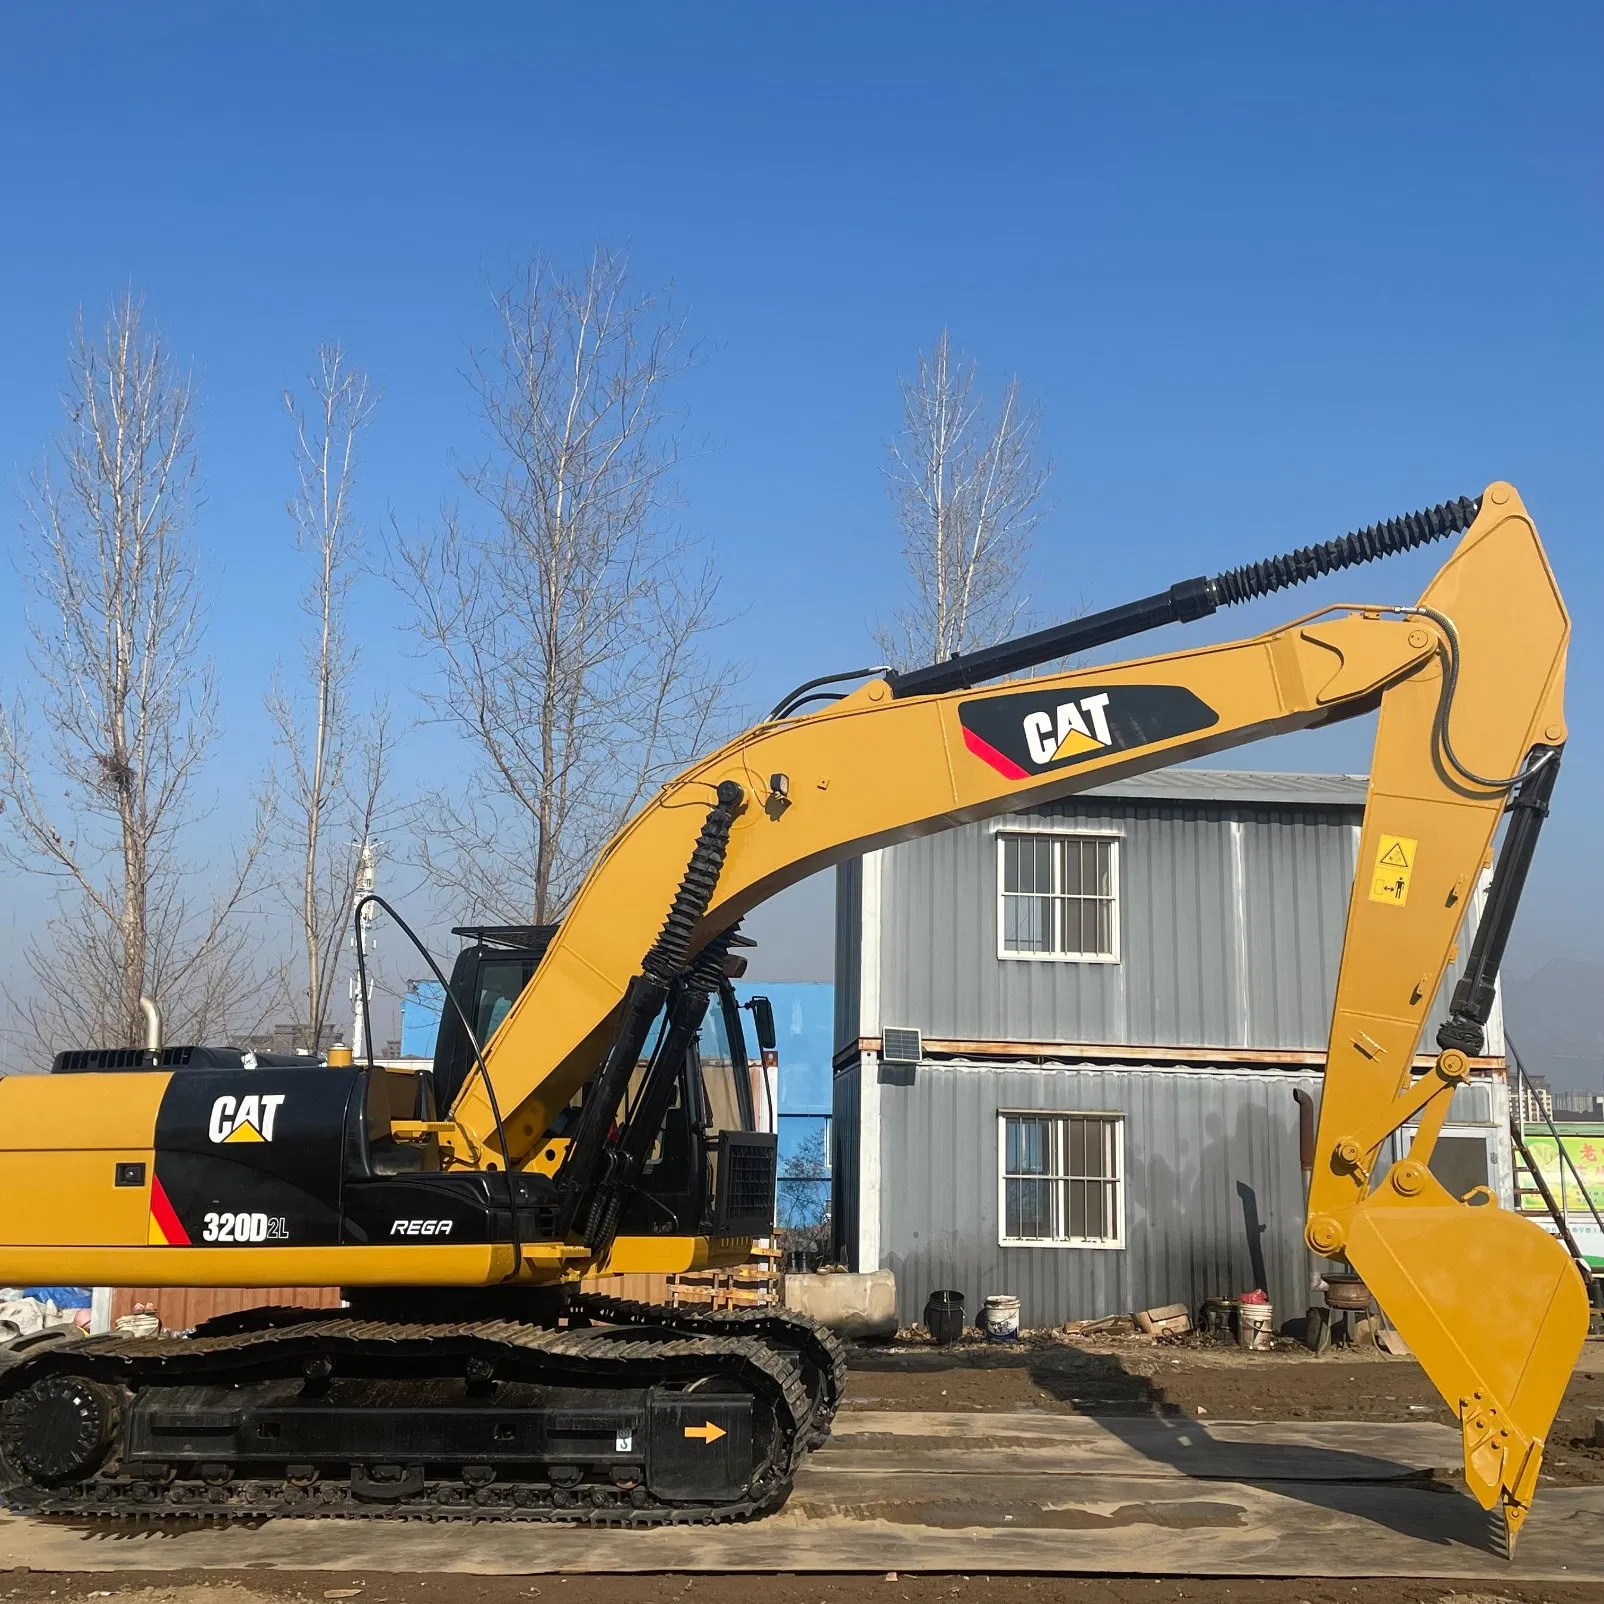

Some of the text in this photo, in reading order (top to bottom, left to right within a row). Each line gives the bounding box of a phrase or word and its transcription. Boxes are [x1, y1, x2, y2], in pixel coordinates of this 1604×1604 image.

[1023, 692, 1112, 765] CAT
[208, 1094, 285, 1143] CAT
[390, 1219, 453, 1236] REGA
